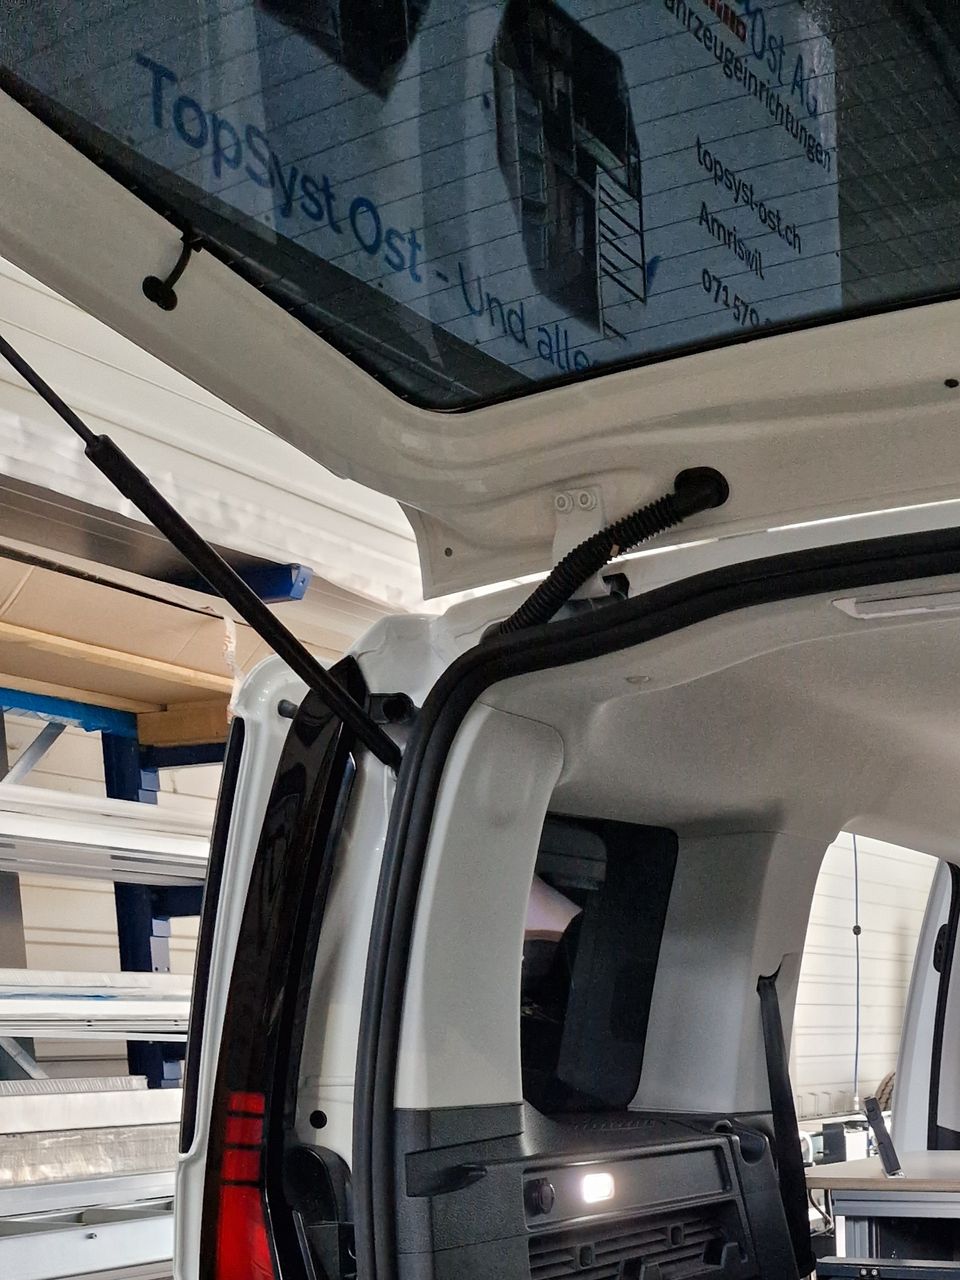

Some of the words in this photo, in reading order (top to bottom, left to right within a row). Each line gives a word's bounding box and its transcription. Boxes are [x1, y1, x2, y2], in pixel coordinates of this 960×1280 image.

[751, 9, 786, 87] Ost
[135, 52, 343, 235] TopSyst
[349, 196, 423, 284] Ost
[458, 261, 529, 350] Und
[696, 136, 801, 254] topsyst-ost.ch
[700, 201, 765, 281] Amriswil
